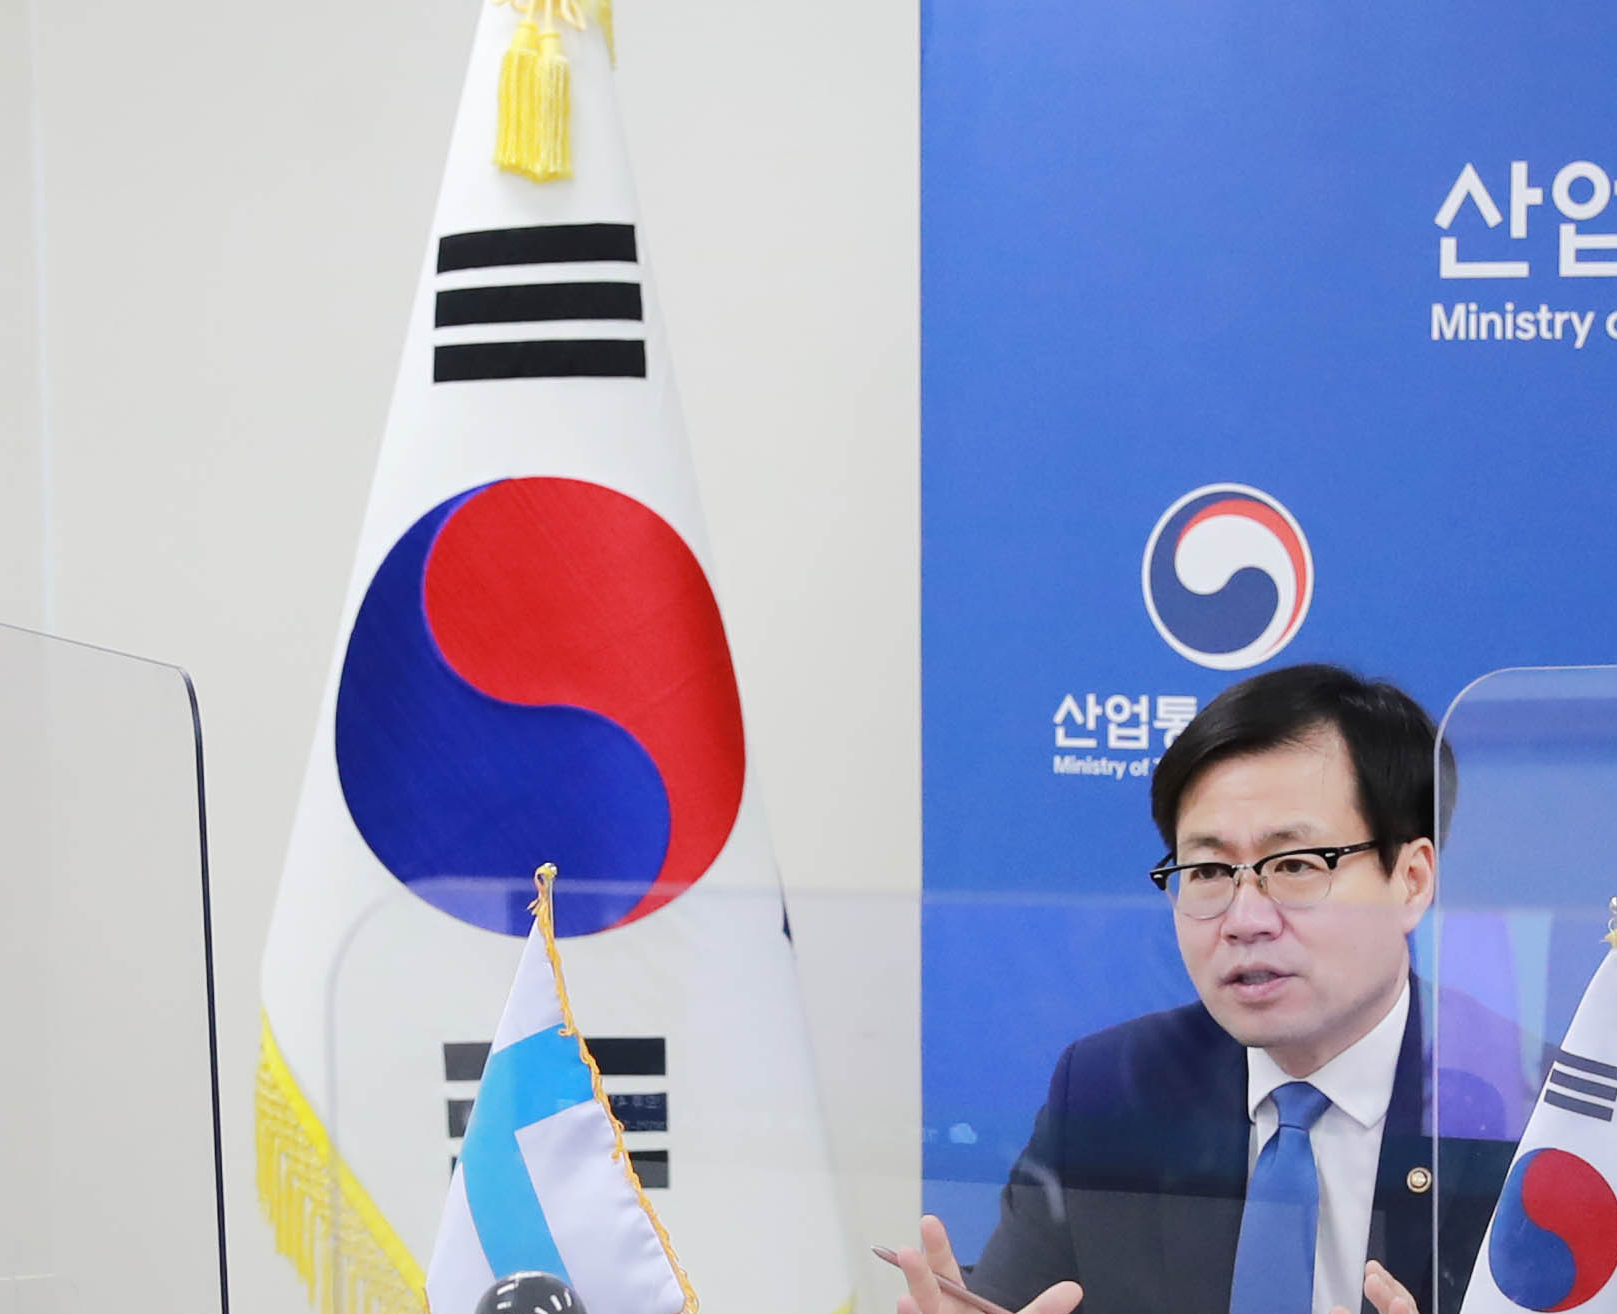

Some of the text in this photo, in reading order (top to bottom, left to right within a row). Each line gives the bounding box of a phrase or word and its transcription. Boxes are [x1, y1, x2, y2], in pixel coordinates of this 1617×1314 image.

[1430, 303, 1595, 349] Ministry
[1052, 754, 1150, 780] Ministry of
